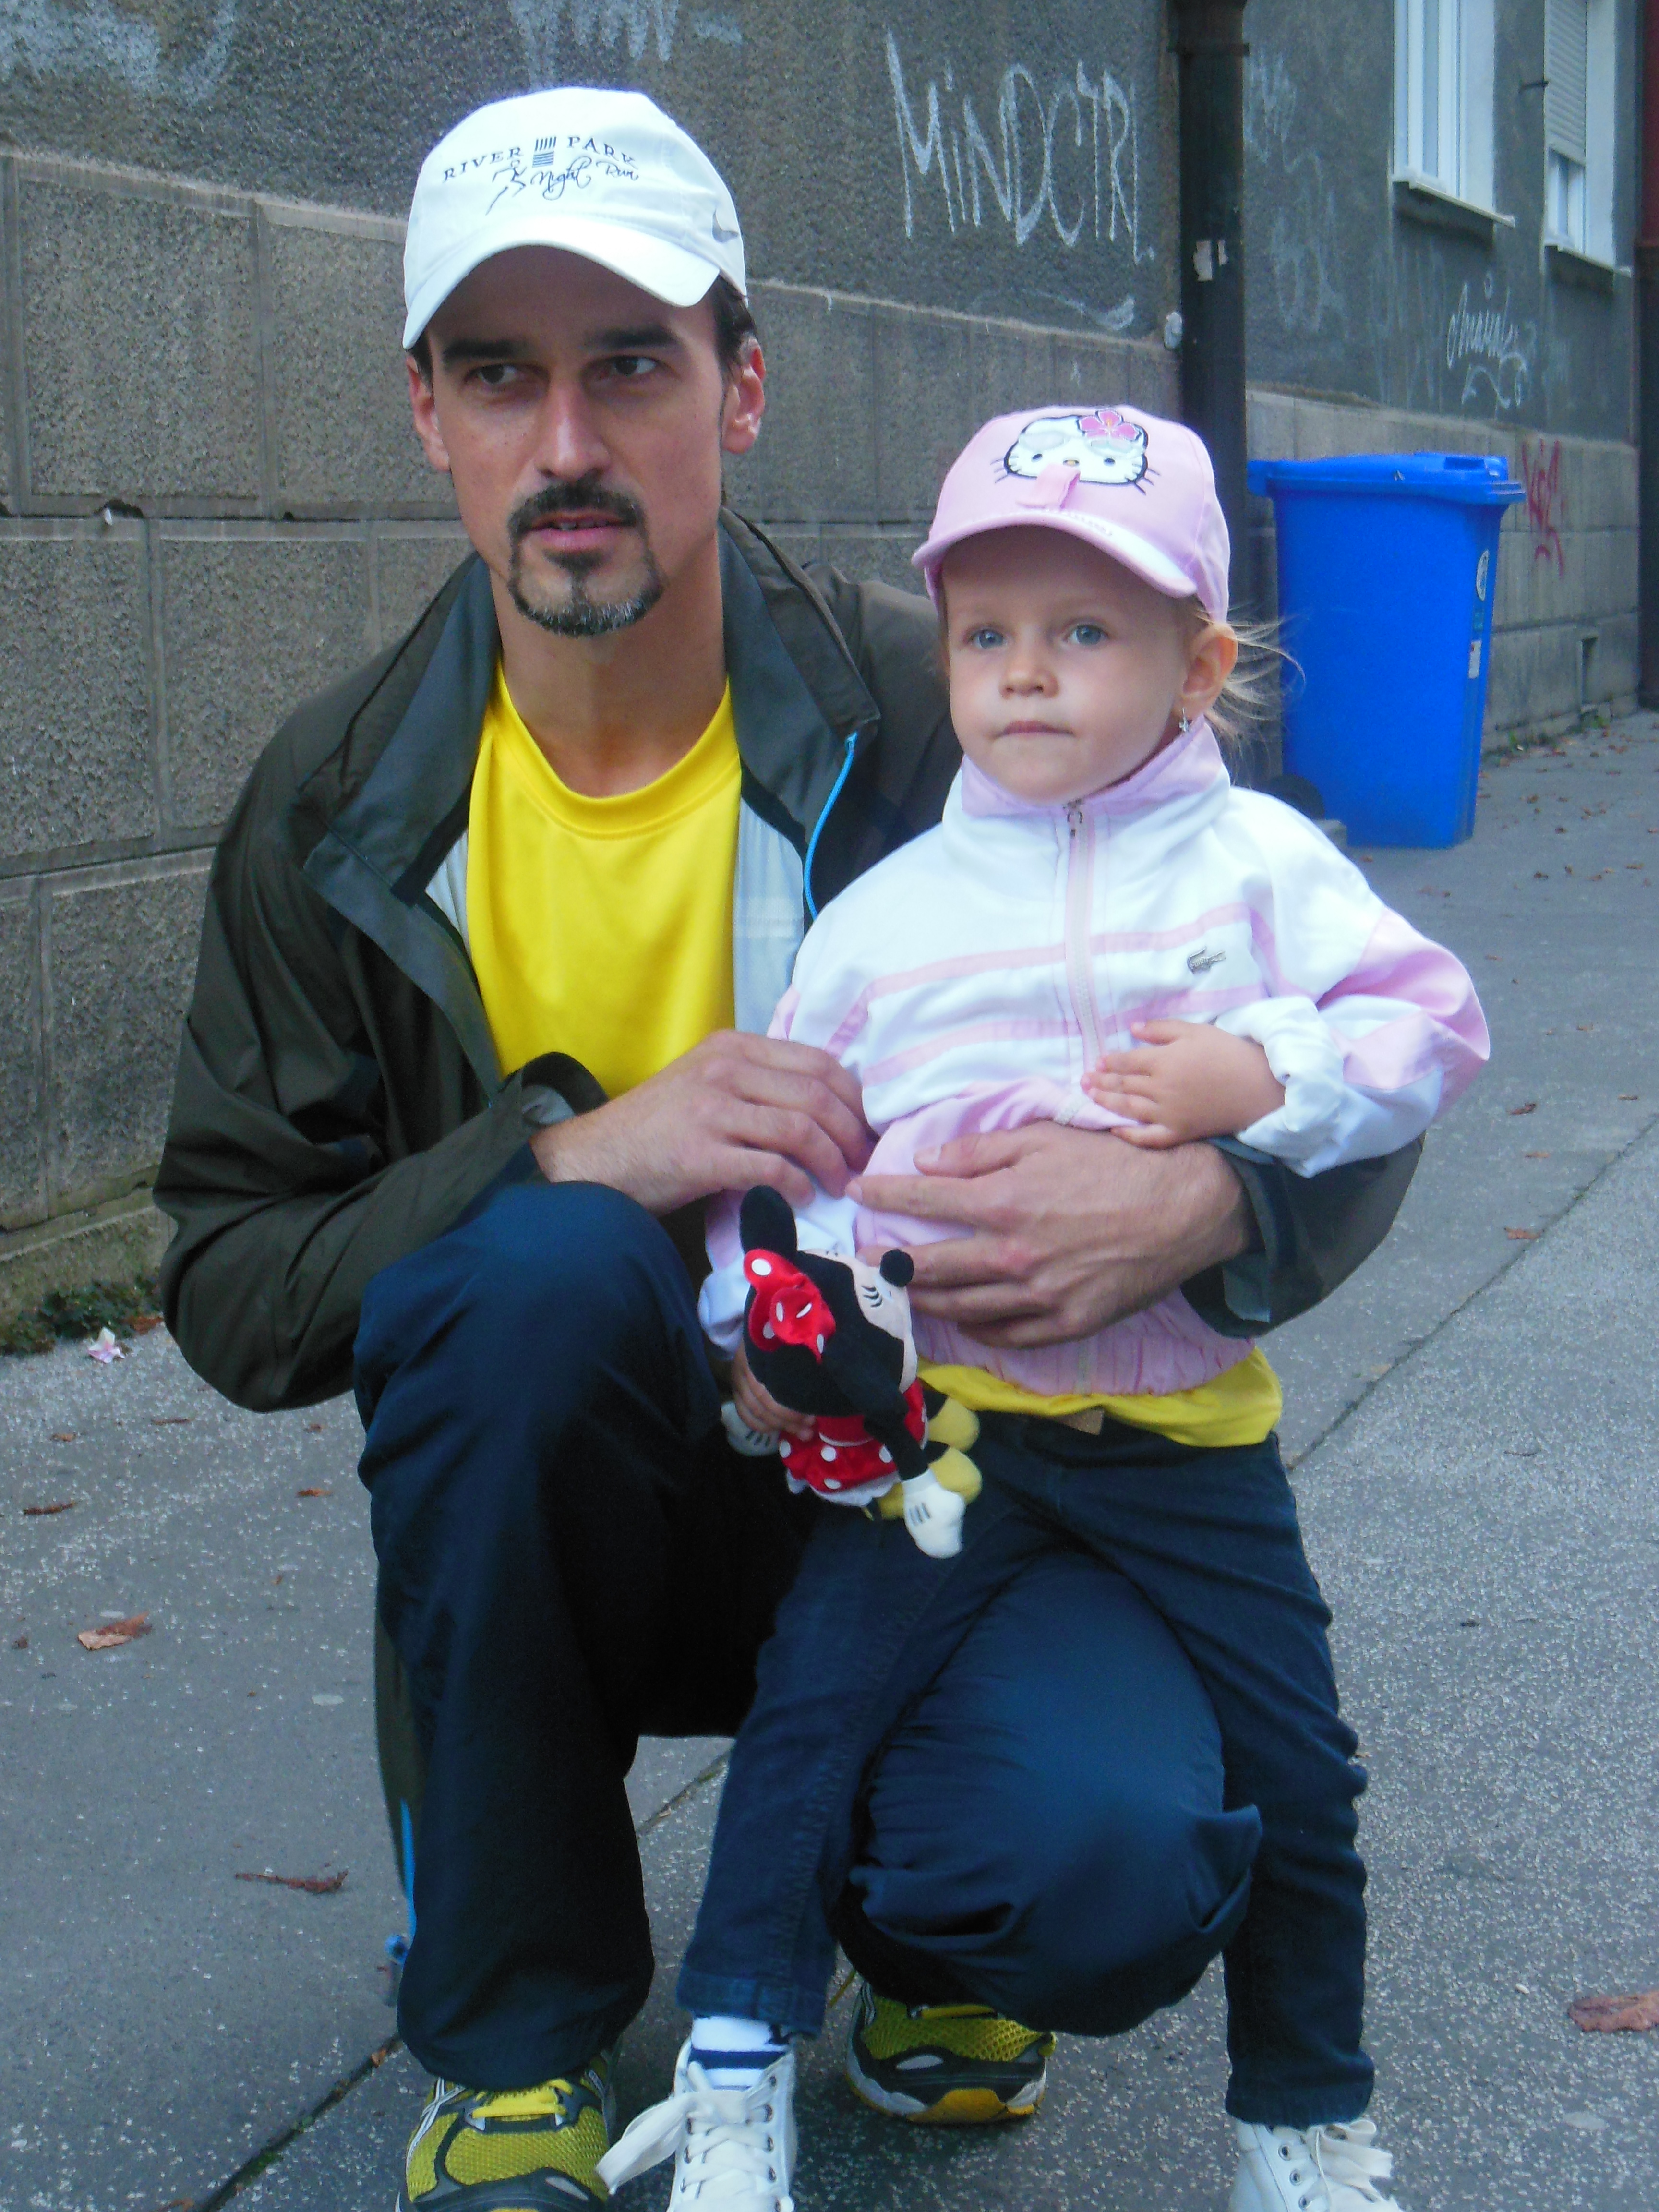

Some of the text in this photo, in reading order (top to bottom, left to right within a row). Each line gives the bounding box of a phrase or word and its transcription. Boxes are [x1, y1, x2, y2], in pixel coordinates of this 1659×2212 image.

[442, 136, 638, 183] RIVER PARK
[530, 156, 639, 201] Night Run
